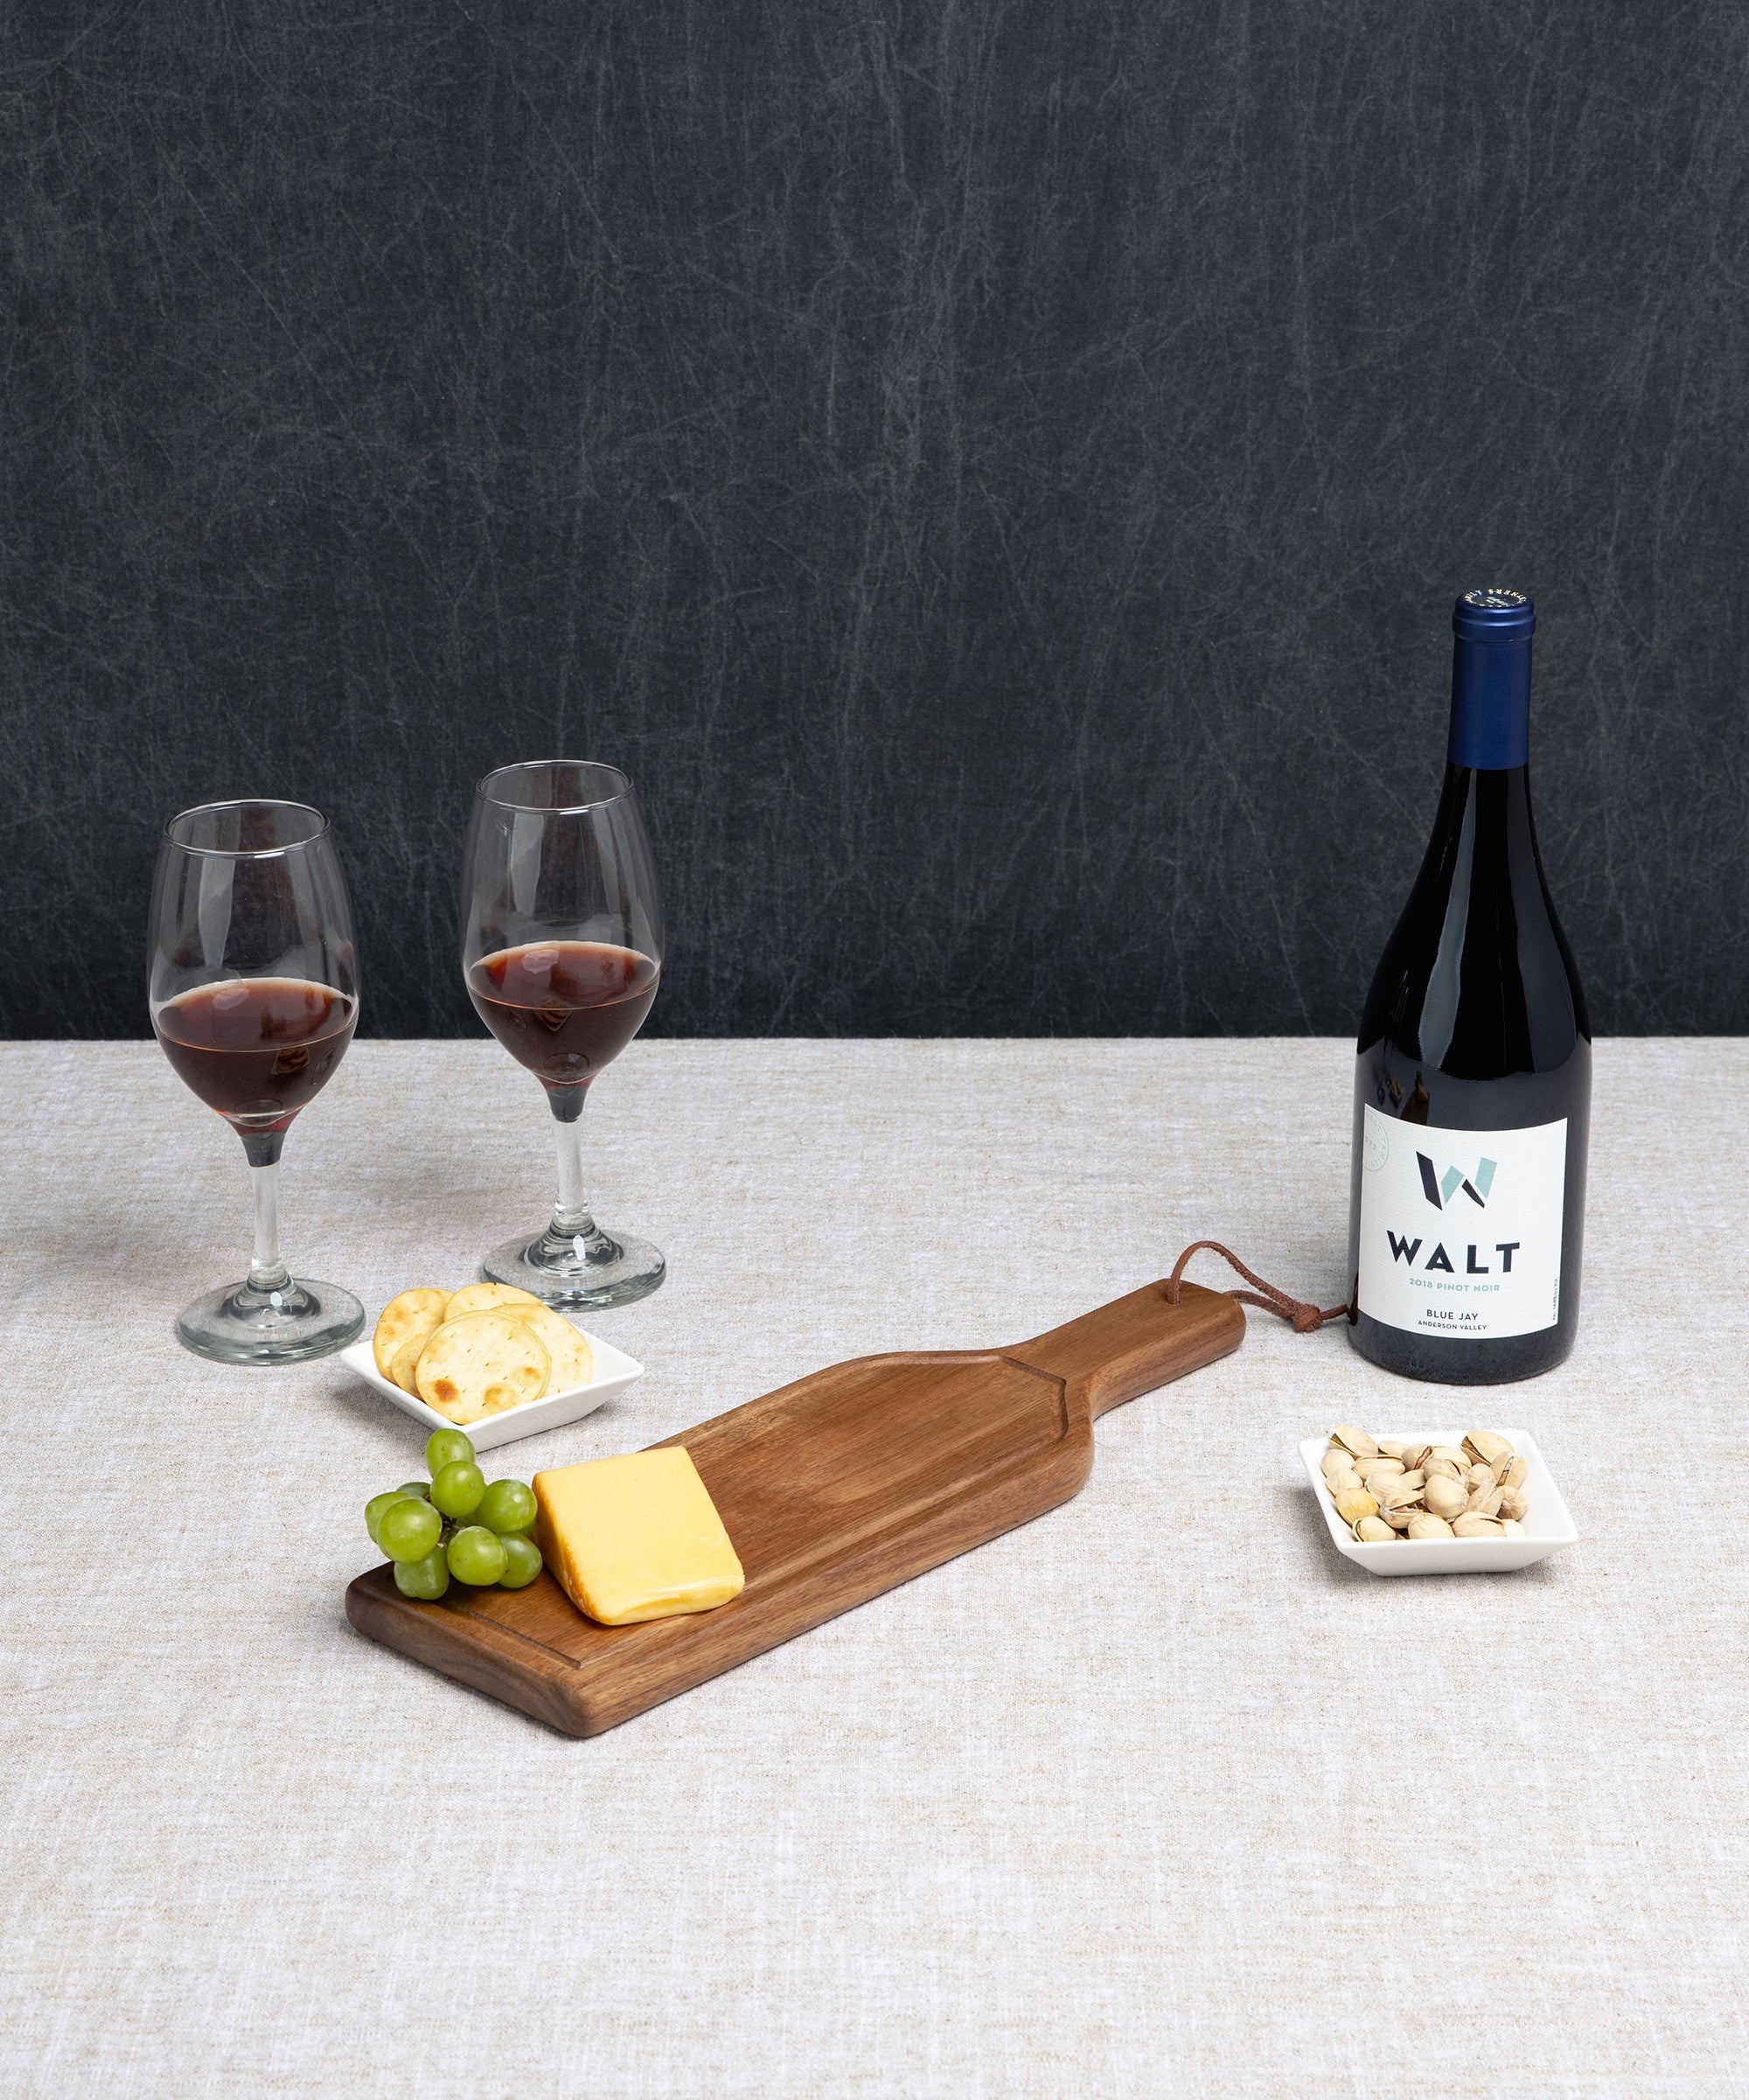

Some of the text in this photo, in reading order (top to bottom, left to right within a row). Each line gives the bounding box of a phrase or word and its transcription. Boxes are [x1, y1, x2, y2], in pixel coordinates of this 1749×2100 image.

[1386, 1230, 1521, 1274] WALT
[1409, 1277, 1501, 1293] 2018 PINOT NOIR
[1426, 1308, 1479, 1322] BLUE JAY
[1418, 1320, 1458, 1330] ANDERSON
